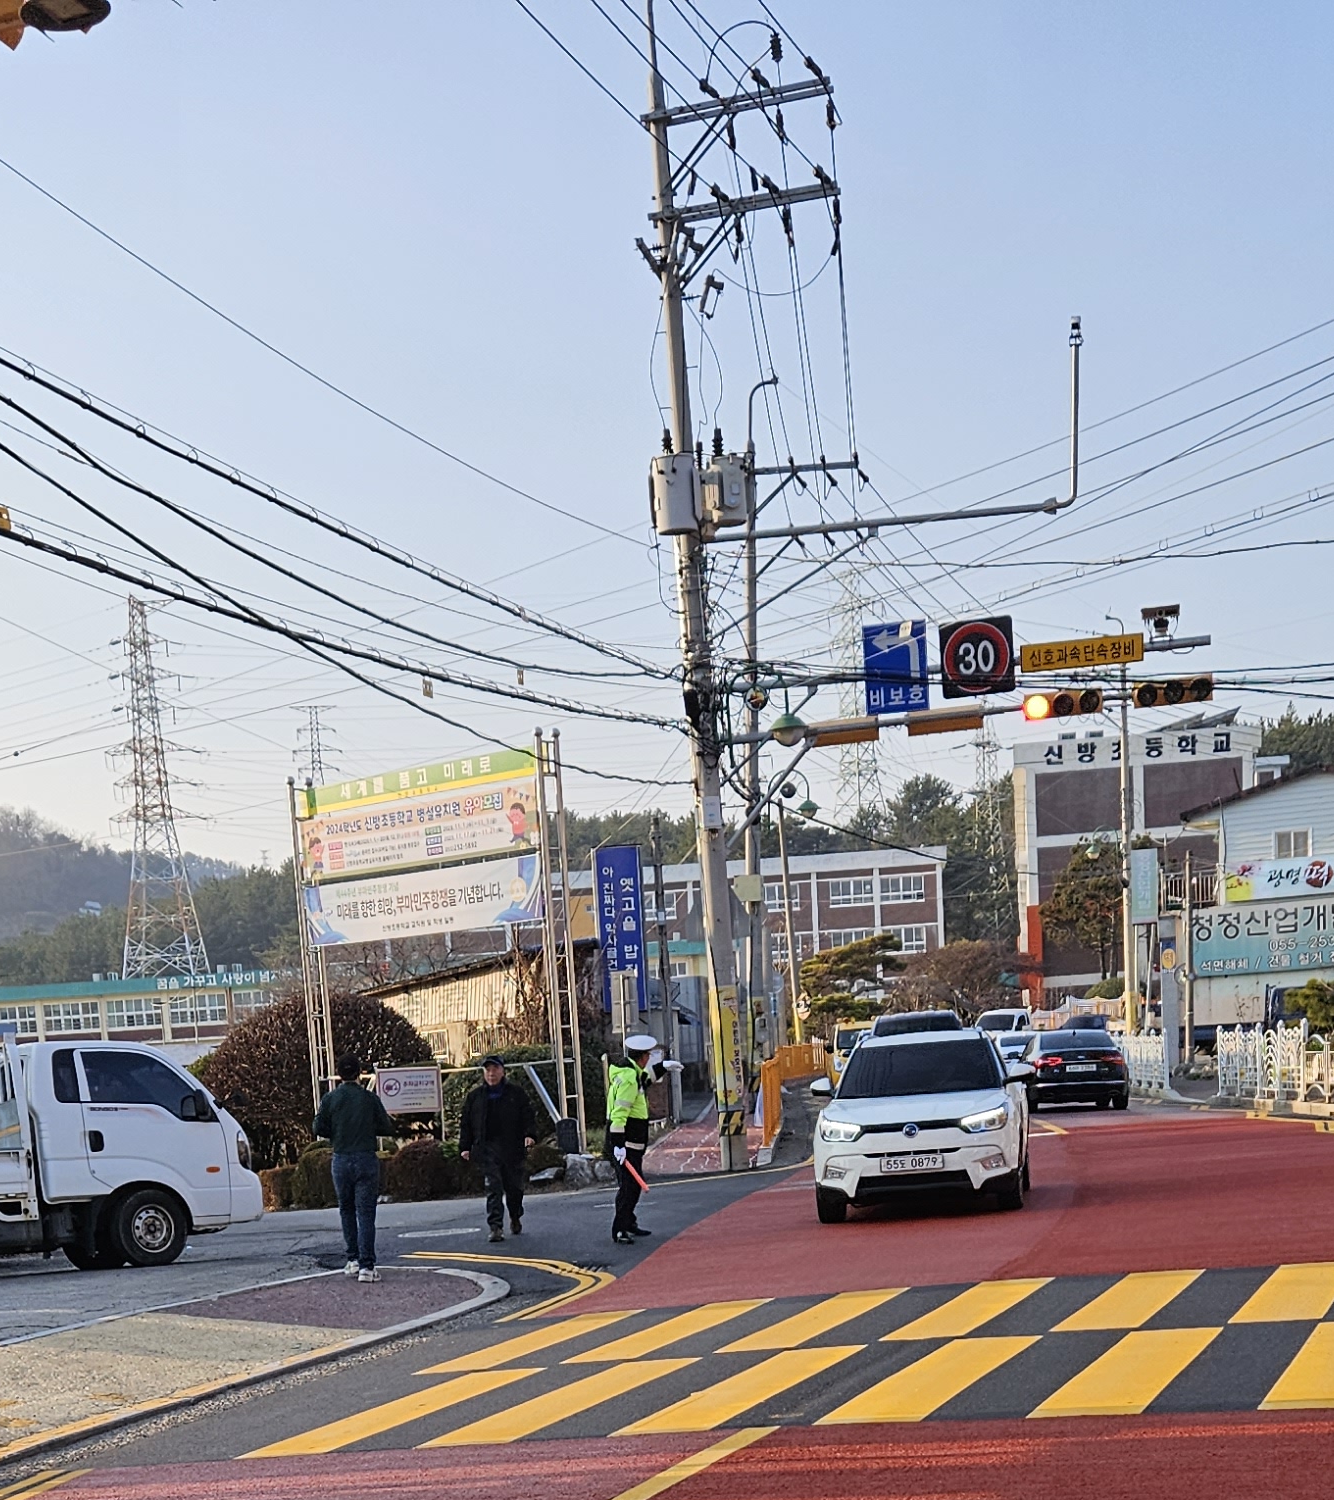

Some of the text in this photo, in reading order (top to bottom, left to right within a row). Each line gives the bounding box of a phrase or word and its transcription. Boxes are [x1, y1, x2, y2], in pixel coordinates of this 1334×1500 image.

[959, 640, 995, 675] 30
[1030, 639, 1135, 667] 신호과속단속장비
[869, 686, 925, 708] 비보호
[340, 756, 492, 799] 세계를 품고 미래로
[365, 809, 412, 831] 신방초등학교
[416, 801, 460, 823] 병설유치원
[464, 792, 503, 816] 유아모집
[337, 882, 504, 920] 미래를 향한 희망, 부마민주항쟁을 기념합니다.
[620, 877, 636, 932] 옛고을
[1201, 957, 1249, 972] 석면해체
[1268, 954, 1292, 968] 건물
[183, 974, 217, 987] 가꾸고
[222, 971, 255, 986] 사랑이
[911, 1157, 938, 1168] 0879
